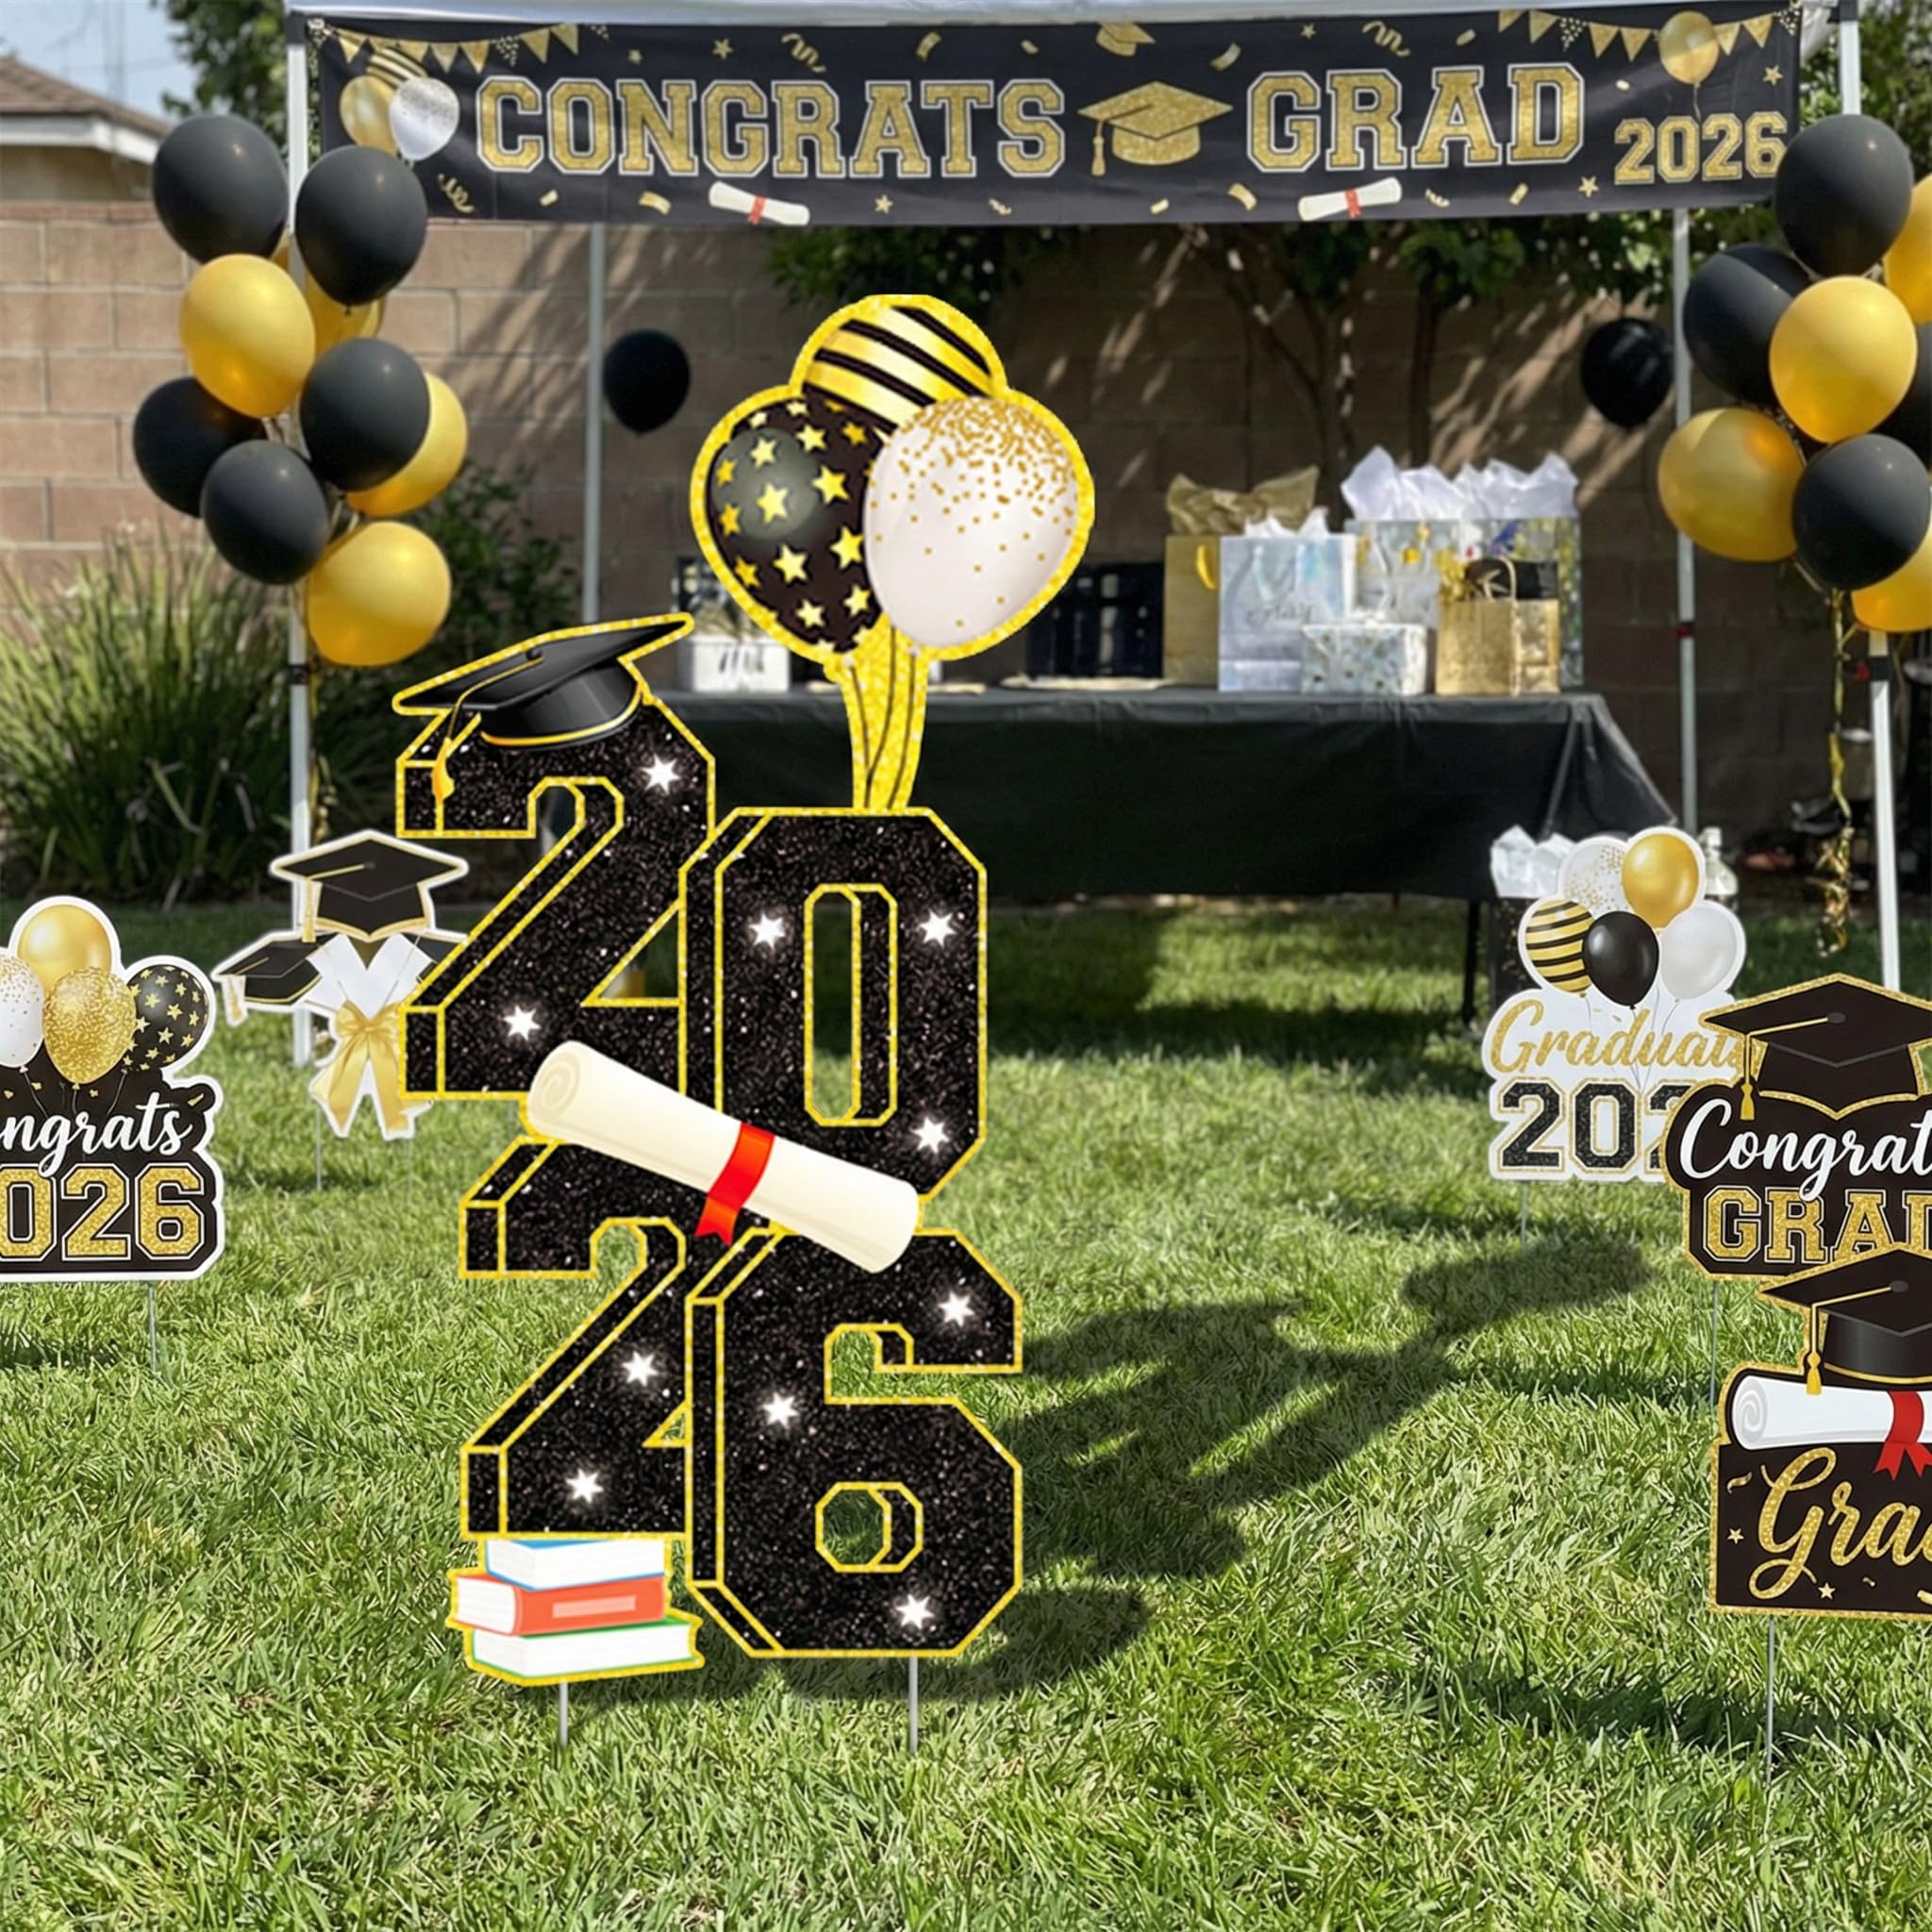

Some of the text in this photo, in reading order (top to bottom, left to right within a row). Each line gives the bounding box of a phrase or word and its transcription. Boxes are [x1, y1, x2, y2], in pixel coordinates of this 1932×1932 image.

[476, 61, 1586, 178] CONGRATS GRAD
[1614, 110, 1788, 186] 2026
[1490, 998, 1743, 1074] Graduat
[1749, 1446, 1932, 1600] Gra
